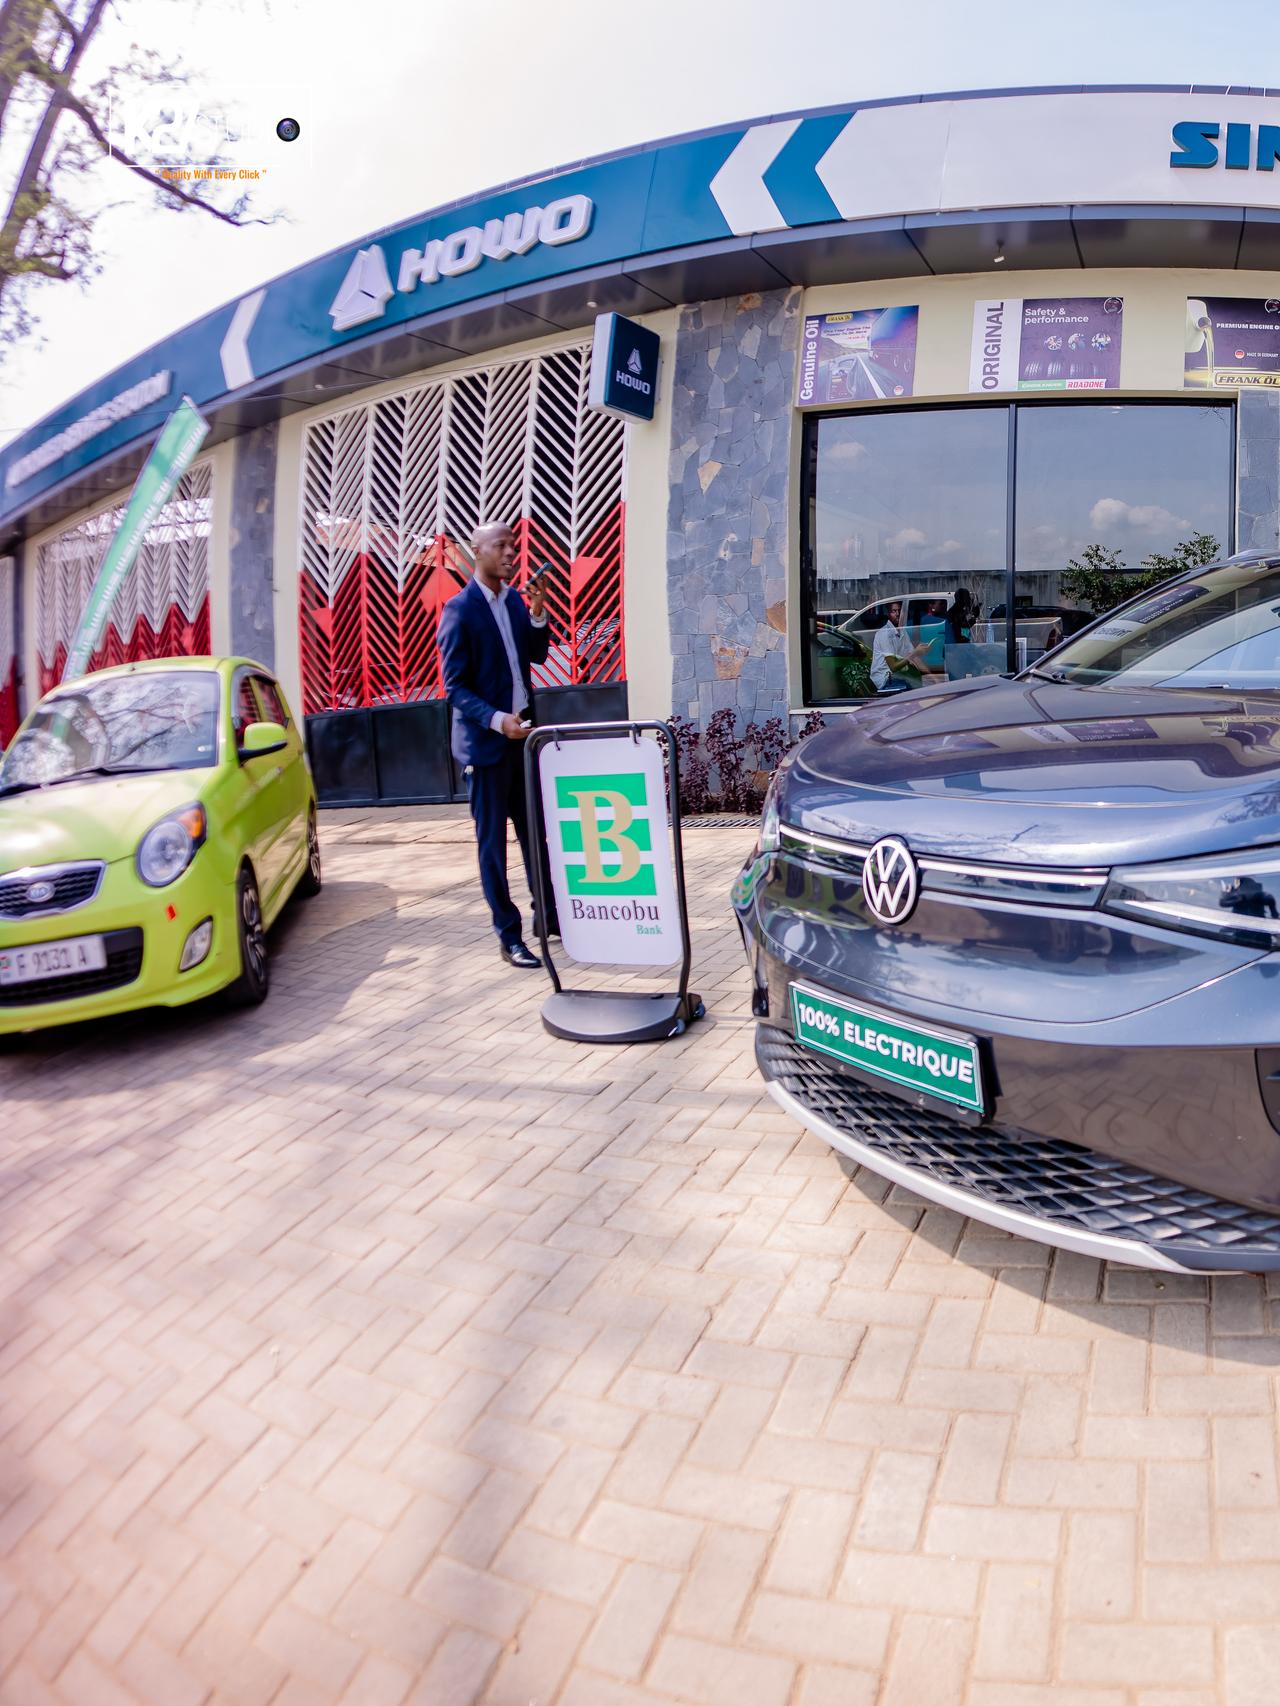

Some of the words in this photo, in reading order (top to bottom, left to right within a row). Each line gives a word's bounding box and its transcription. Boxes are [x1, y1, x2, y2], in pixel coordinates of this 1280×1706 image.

[397, 194, 594, 293] HOWO
[1025, 308, 1057, 318] Safety
[1058, 308, 1066, 316] &
[1025, 315, 1089, 325] performance
[805, 319, 820, 339] Oil
[1216, 322, 1249, 330] PREMIUM
[981, 301, 1004, 390] ORIGINAL
[800, 341, 817, 400] Genuine
[1217, 376, 1261, 385] FRANK
[1263, 374, 1280, 386] ÖL
[616, 369, 651, 395] HOWO
[1067, 381, 1104, 389] ROADONE
[570, 898, 660, 921] Bancobu
[635, 923, 663, 936] Bank
[798, 1002, 840, 1037] 100%
[843, 1020, 974, 1085] ELECTRIQUE
